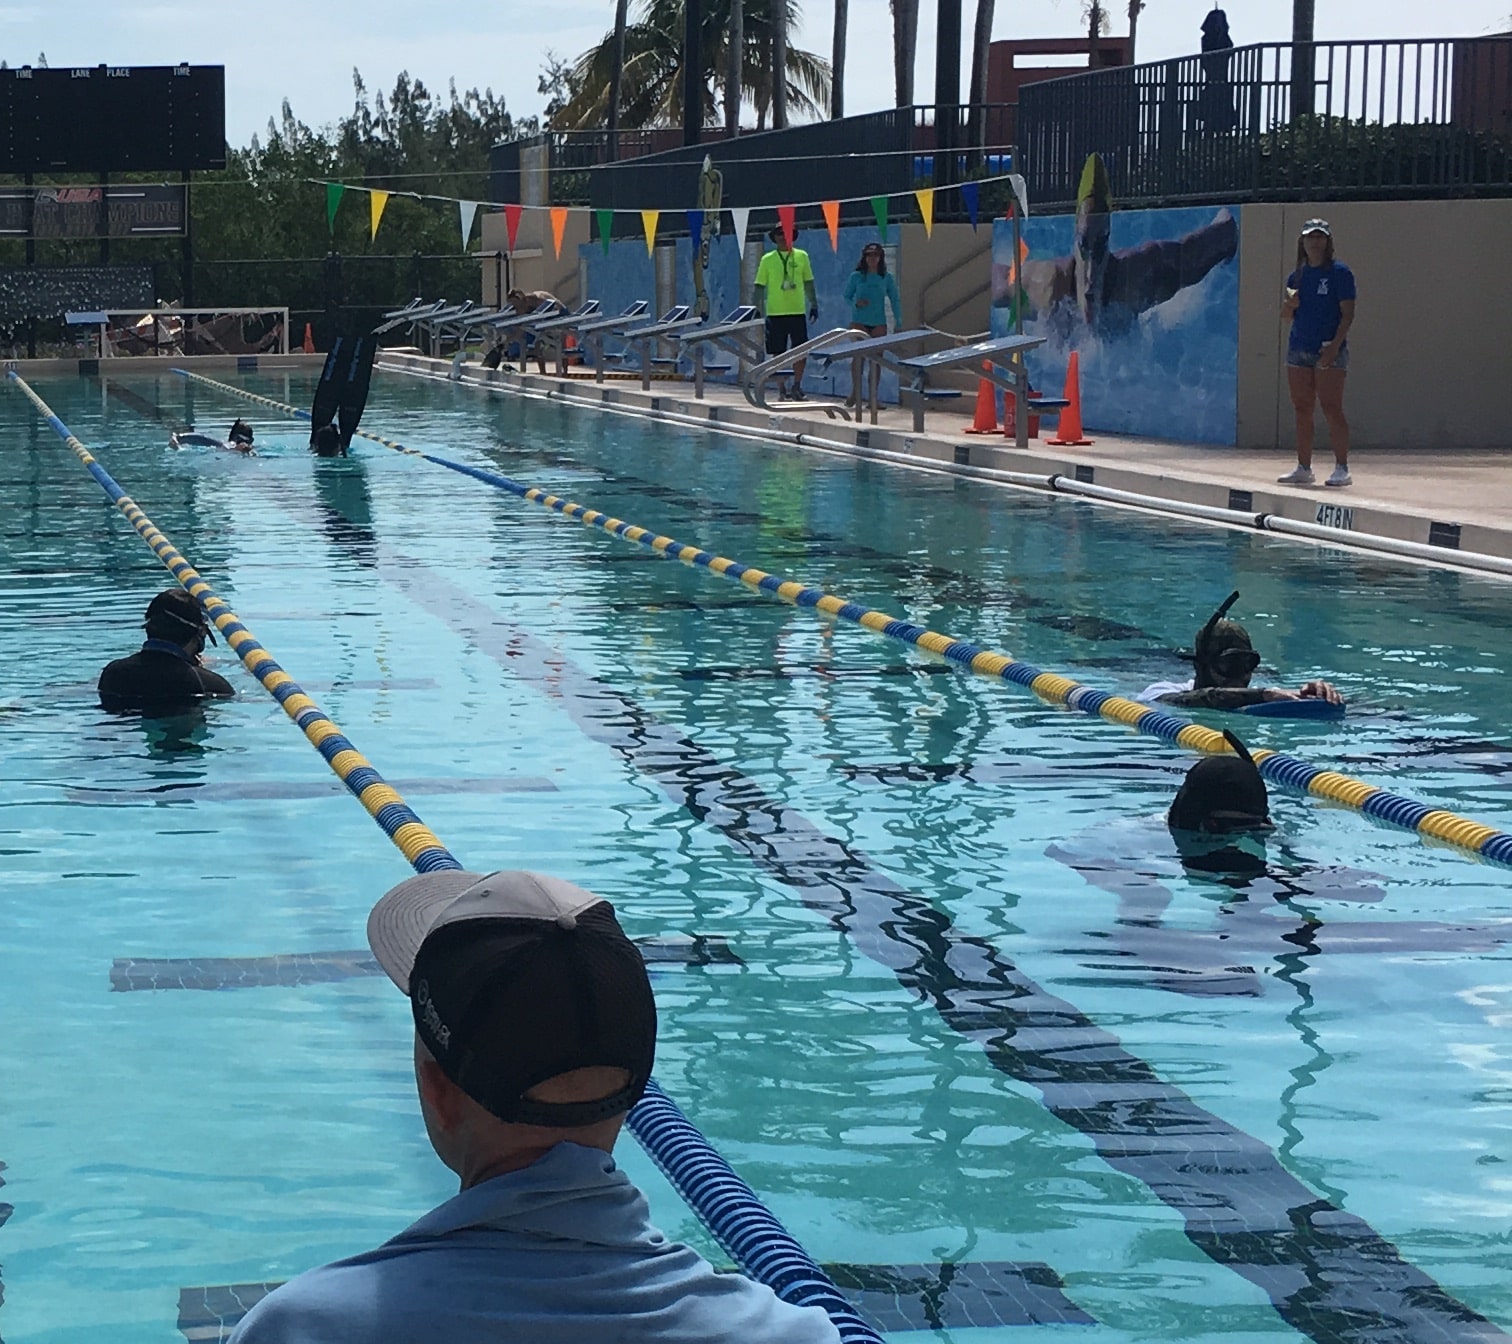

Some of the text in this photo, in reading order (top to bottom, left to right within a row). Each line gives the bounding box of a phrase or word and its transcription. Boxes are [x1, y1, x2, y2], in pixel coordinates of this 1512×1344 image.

[15, 69, 33, 79] TIME
[71, 69, 90, 79] LANE
[106, 68, 130, 78] PLACE
[173, 67, 191, 77] TIME
